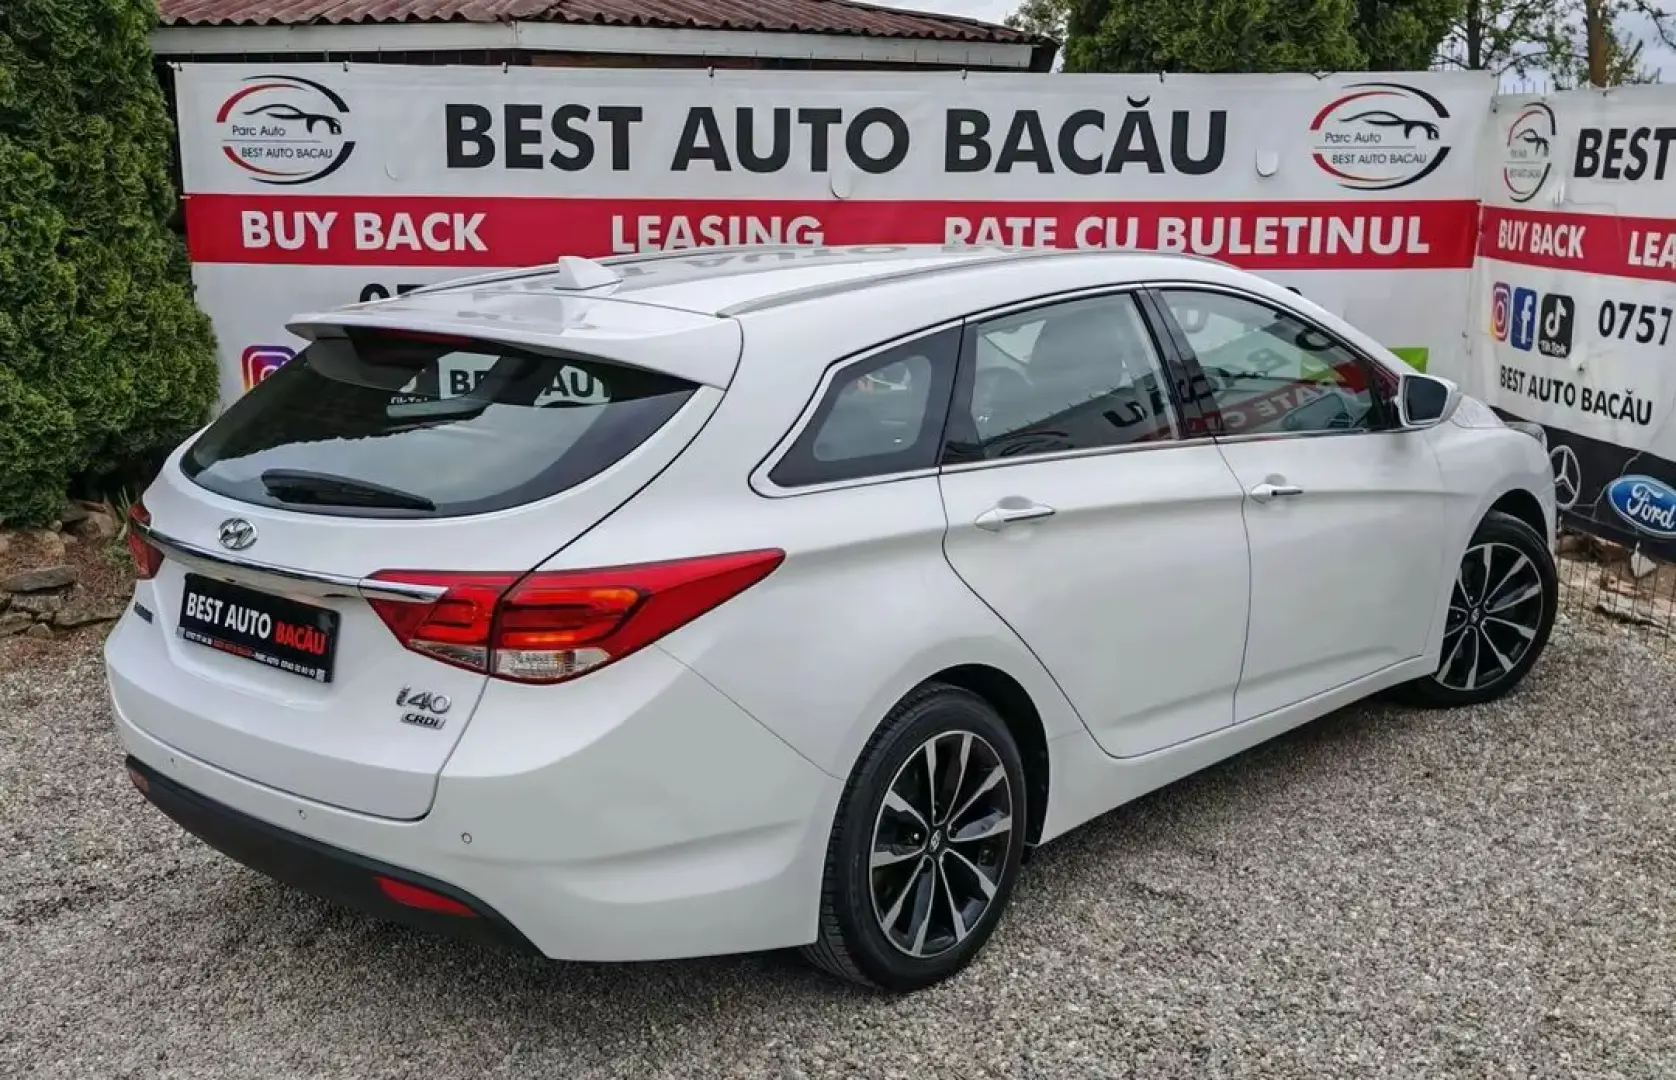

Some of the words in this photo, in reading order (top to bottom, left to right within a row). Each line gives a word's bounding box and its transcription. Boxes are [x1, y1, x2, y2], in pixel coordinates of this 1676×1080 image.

[232, 125, 256, 137] Parc
[260, 125, 286, 137] Auto
[445, 103, 643, 172] BEST
[670, 106, 910, 175] AUTO
[943, 95, 1228, 176] BACĂU
[1324, 131, 1350, 144] Parc
[1353, 131, 1382, 144] Auto
[241, 147, 265, 159] BEST
[266, 148, 294, 159] AUTO
[1331, 153, 1355, 165] BEST
[1357, 153, 1386, 165] AUTO
[1573, 126, 1676, 181] BEST
[240, 210, 339, 250] BUY
[354, 211, 489, 252] BACK
[611, 215, 825, 253] LEASING
[943, 216, 1057, 250] RATE
[1074, 216, 1138, 252] CU
[1157, 216, 1430, 254] BULETINUL
[1497, 218, 1528, 252] BUY
[1530, 222, 1587, 259] BACK
[1598, 299, 1674, 346] 0757
[1500, 365, 1526, 393] BEST
[1527, 375, 1577, 407] AUTO
[1580, 388, 1653, 426] BACĂU
[1627, 482, 1676, 530] Ford
[185, 592, 225, 625] BEST
[224, 603, 272, 640] AUTO
[275, 620, 326, 655] BACĂU
